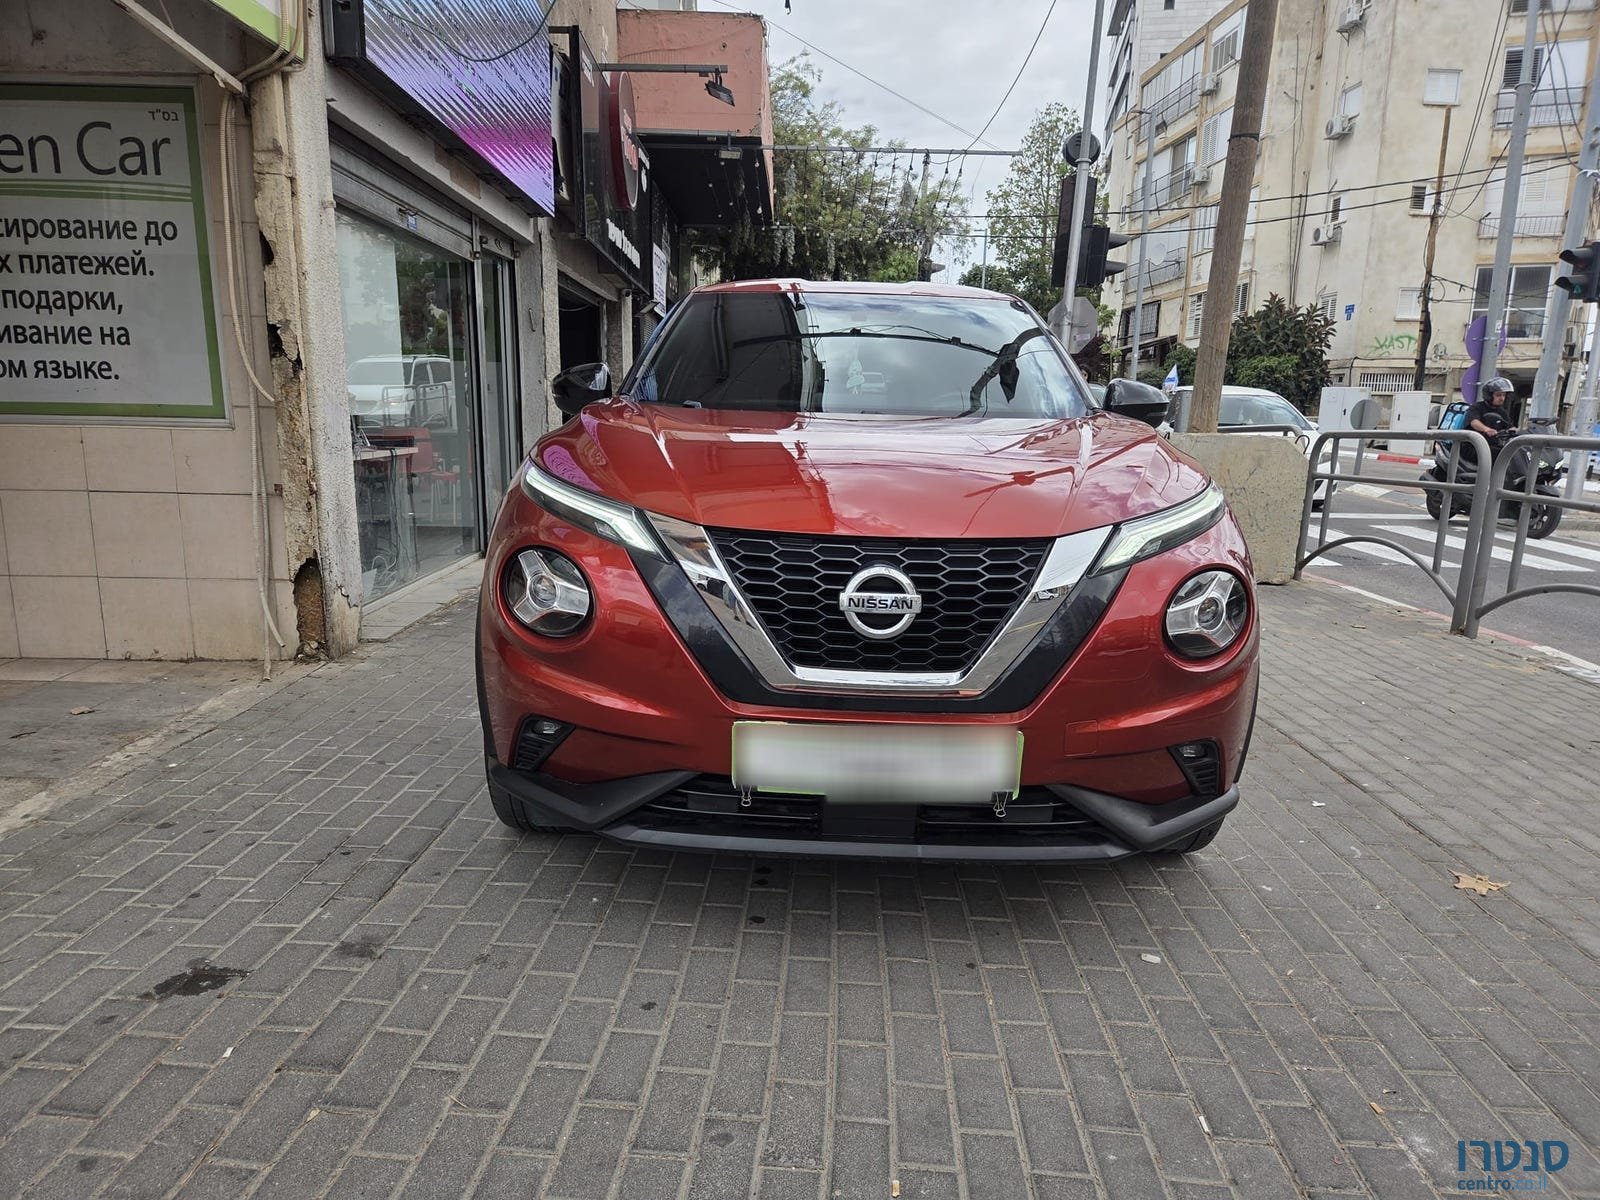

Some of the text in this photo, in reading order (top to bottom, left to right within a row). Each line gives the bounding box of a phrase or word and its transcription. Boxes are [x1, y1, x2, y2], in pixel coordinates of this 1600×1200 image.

[148, 109, 179, 122] בס"ד
[0, 121, 171, 176] en Car
[0, 217, 178, 246] ирование до
[18, 249, 155, 276] платежей.
[1, 289, 124, 317] подарки,
[0, 324, 131, 346] ивание на
[33, 359, 120, 380] языке.
[847, 597, 914, 610] NISSAN
